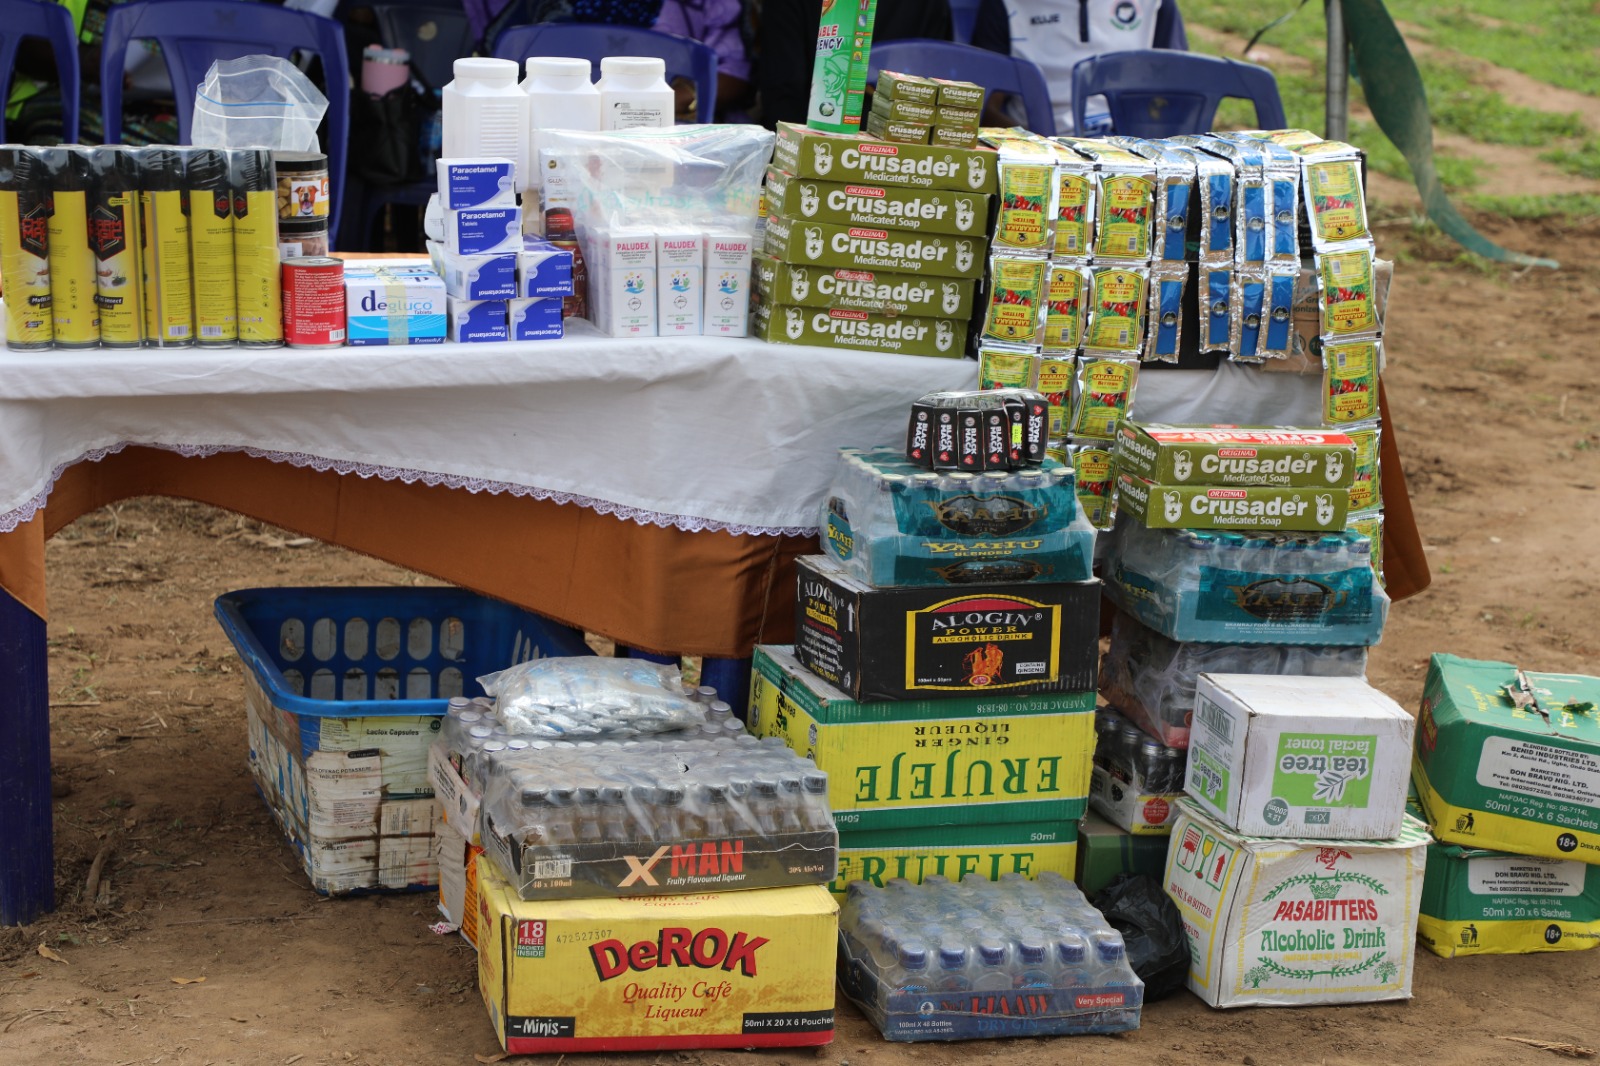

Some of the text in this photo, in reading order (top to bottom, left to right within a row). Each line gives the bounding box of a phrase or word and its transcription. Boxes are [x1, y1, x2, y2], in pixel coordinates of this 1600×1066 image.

[896, 83, 934, 94] Crusader
[943, 88, 981, 98] Crusader
[896, 104, 934, 115] Crusader
[940, 108, 978, 118] Crusader
[888, 125, 926, 136] Crusader
[938, 129, 975, 139] Crusader
[841, 148, 960, 177] Crusader
[452, 166, 497, 174] Paracetamol
[864, 172, 933, 186] Medicated Soap
[827, 190, 948, 220] Crusader
[850, 213, 920, 228] Medicated Soap
[617, 242, 649, 250] PALUDEX
[664, 241, 696, 249] PALUDEX
[715, 242, 747, 251] PALUDEX
[831, 232, 948, 261] Crusader
[854, 256, 921, 270] Medicated Soap
[479, 289, 515, 297] Paracetamol
[817, 275, 934, 303] Crusader
[361, 290, 432, 313] degluco
[840, 297, 907, 311] Medicated Soap
[812, 313, 928, 341] Crusader
[834, 335, 901, 349] Medicated Soap
[913, 422, 924, 448] MACA
[1028, 415, 1036, 442] BLACK
[920, 422, 928, 450] BLACK
[964, 428, 972, 454] MACA
[1117, 429, 1156, 461] Crusader
[1201, 454, 1317, 474] Crusader
[1223, 473, 1290, 484] Medicated Soap
[1118, 476, 1148, 503] Crusader
[1190, 495, 1308, 517] Crusader
[1213, 516, 1281, 527] Medicated Soap
[922, 540, 1043, 553] YAAHU
[932, 612, 1034, 630] ALOGIN
[945, 626, 1018, 635] POWER
[1030, 701, 1048, 711] REG
[1050, 699, 1086, 710] NAFDAC
[914, 722, 1010, 736] LIQUEUR
[914, 736, 1010, 748] GINGER
[1285, 739, 1370, 754] facial toner
[1511, 746, 1598, 768] BENID INDUSTRIES LTD.
[1523, 743, 1548, 752] BLENDED
[1554, 749, 1578, 757] BOTTLED
[1282, 756, 1367, 776] tea tree
[1530, 768, 1560, 776] MARKETED
[856, 750, 1062, 802] ERUJEJE
[1528, 772, 1554, 782] BRAVO
[1573, 781, 1588, 789] LTD.
[1499, 793, 1528, 804] NAFDAC
[1529, 799, 1544, 808] Reg.
[1485, 800, 1510, 812] 50ml
[1522, 808, 1535, 817] 20
[1546, 812, 1554, 821] 6
[1556, 814, 1598, 830] Sachets
[1030, 832, 1056, 841] 50ml
[1558, 837, 1576, 847] 18+
[671, 841, 743, 876] MAN
[667, 873, 746, 887] Fruity Flavoured liqueur
[1193, 899, 1212, 918] BOTTLES
[1273, 899, 1378, 922] PASABITTERS
[1483, 908, 1505, 917] 50ml
[1514, 908, 1526, 916] 20
[1533, 908, 1539, 916] 6
[1541, 909, 1571, 918] Sachets
[520, 922, 544, 938] 18
[556, 929, 612, 944] 472527307
[1546, 929, 1560, 938] 18+
[1261, 926, 1386, 952] Alcoholic Drink
[589, 927, 770, 982] DeROK
[623, 980, 732, 1003] Quality Café
[1078, 996, 1122, 1005] Very Special
[644, 1005, 708, 1022] Liqueur
[744, 1017, 834, 1028] 50ml X 20 X 6 Pouches
[978, 1020, 1038, 1032] DRY GIN
